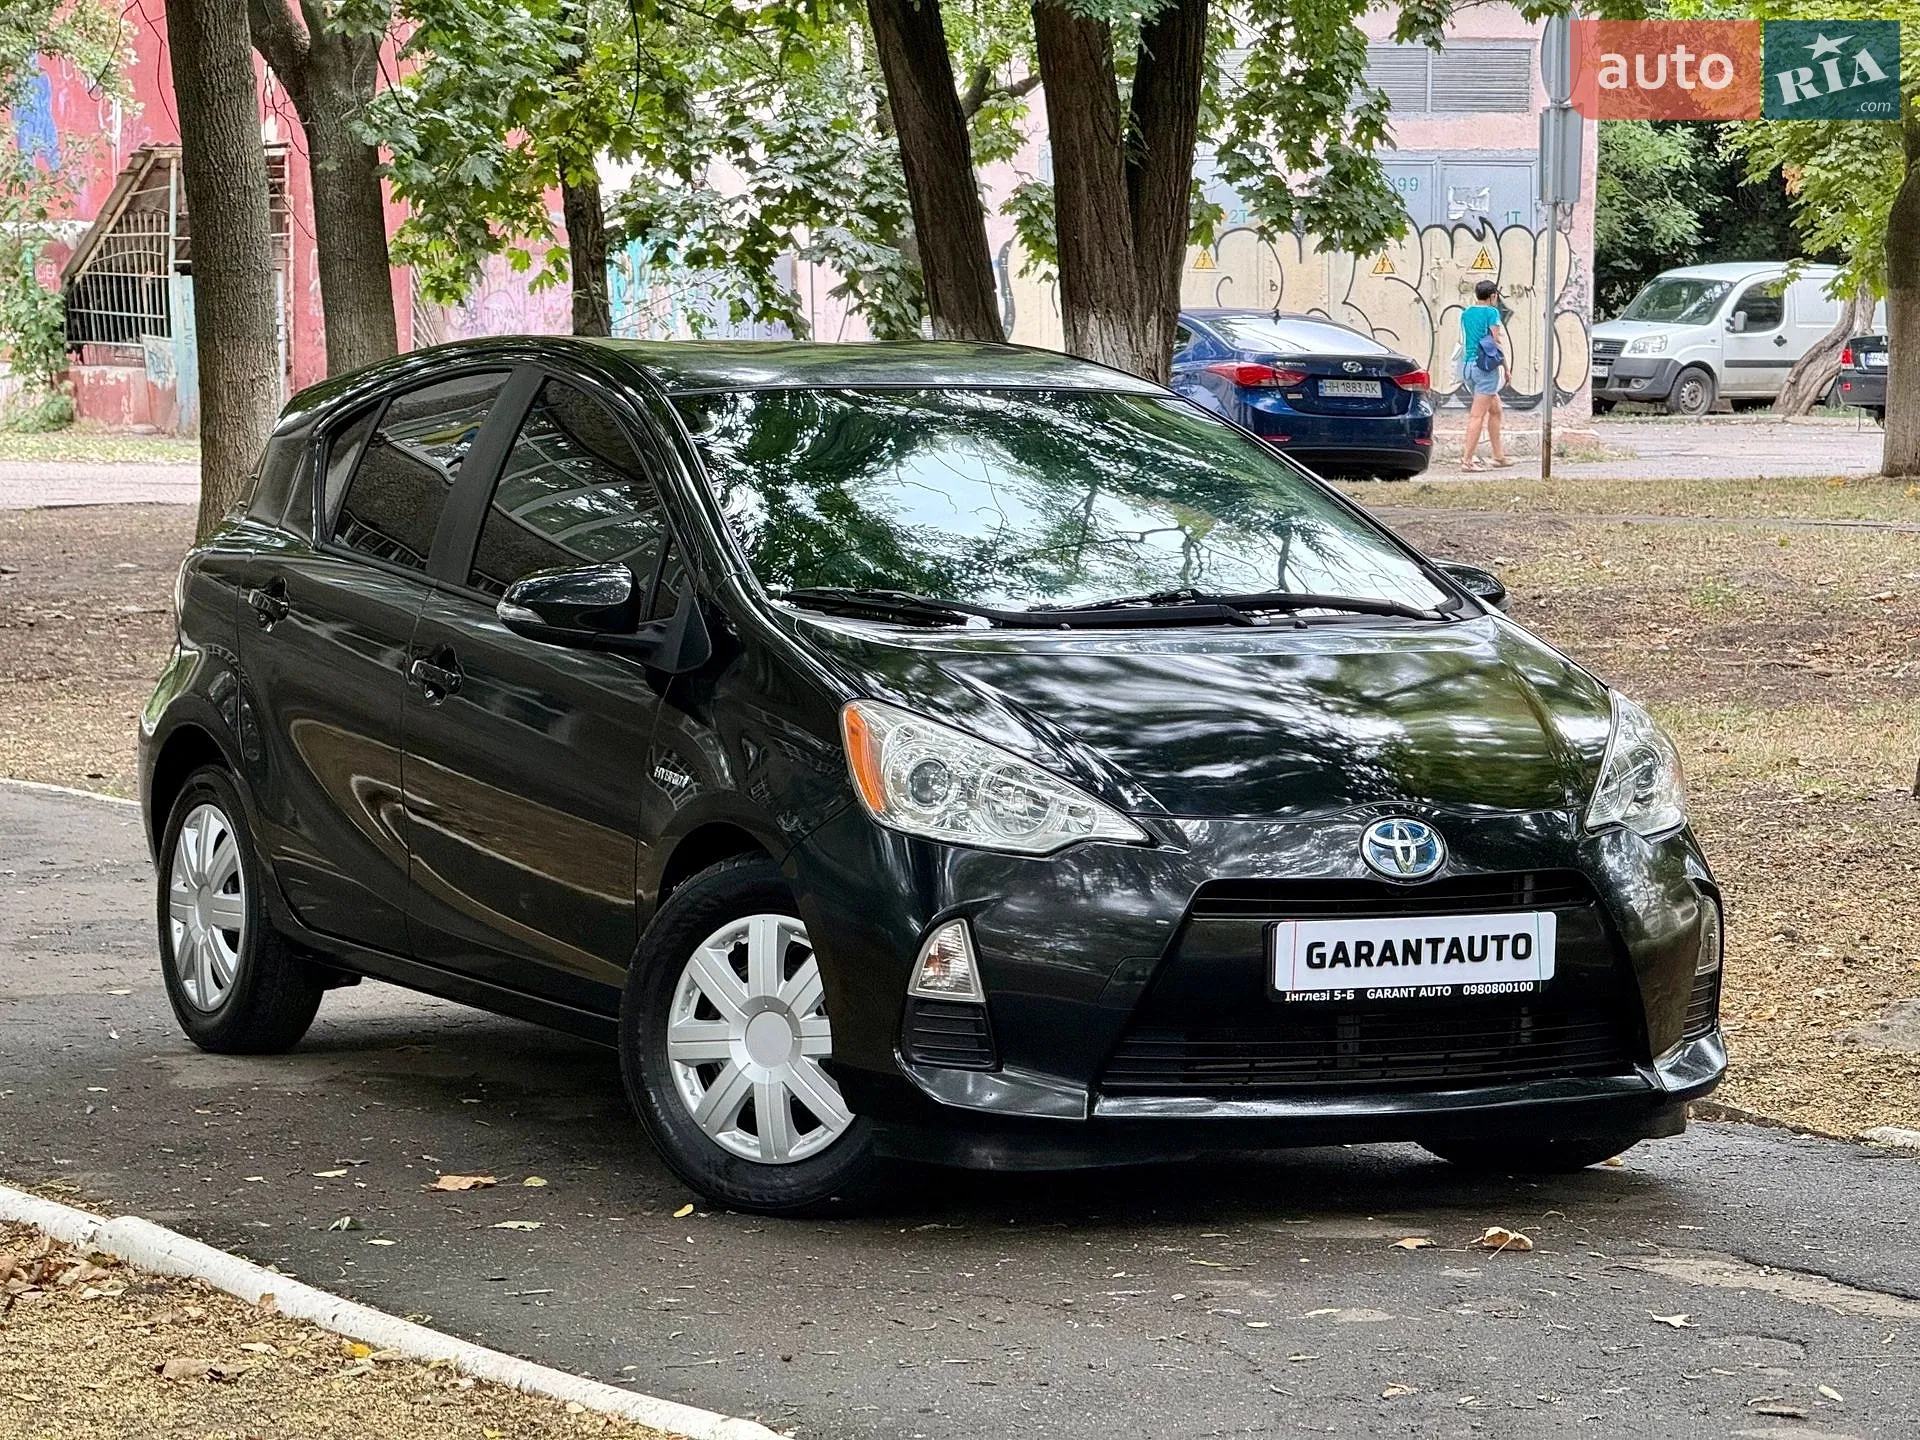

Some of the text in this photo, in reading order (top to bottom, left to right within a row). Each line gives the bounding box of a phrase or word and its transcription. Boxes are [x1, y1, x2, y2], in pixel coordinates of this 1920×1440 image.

[1325, 381, 1379, 394] HH 1883 AK
[1306, 932, 1533, 970] GARANTAUTO
[1333, 989, 1355, 1001] 5-Б
[1366, 987, 1416, 999] GARANT
[1418, 985, 1452, 997] AUTO
[1462, 981, 1534, 996] 0980800100
